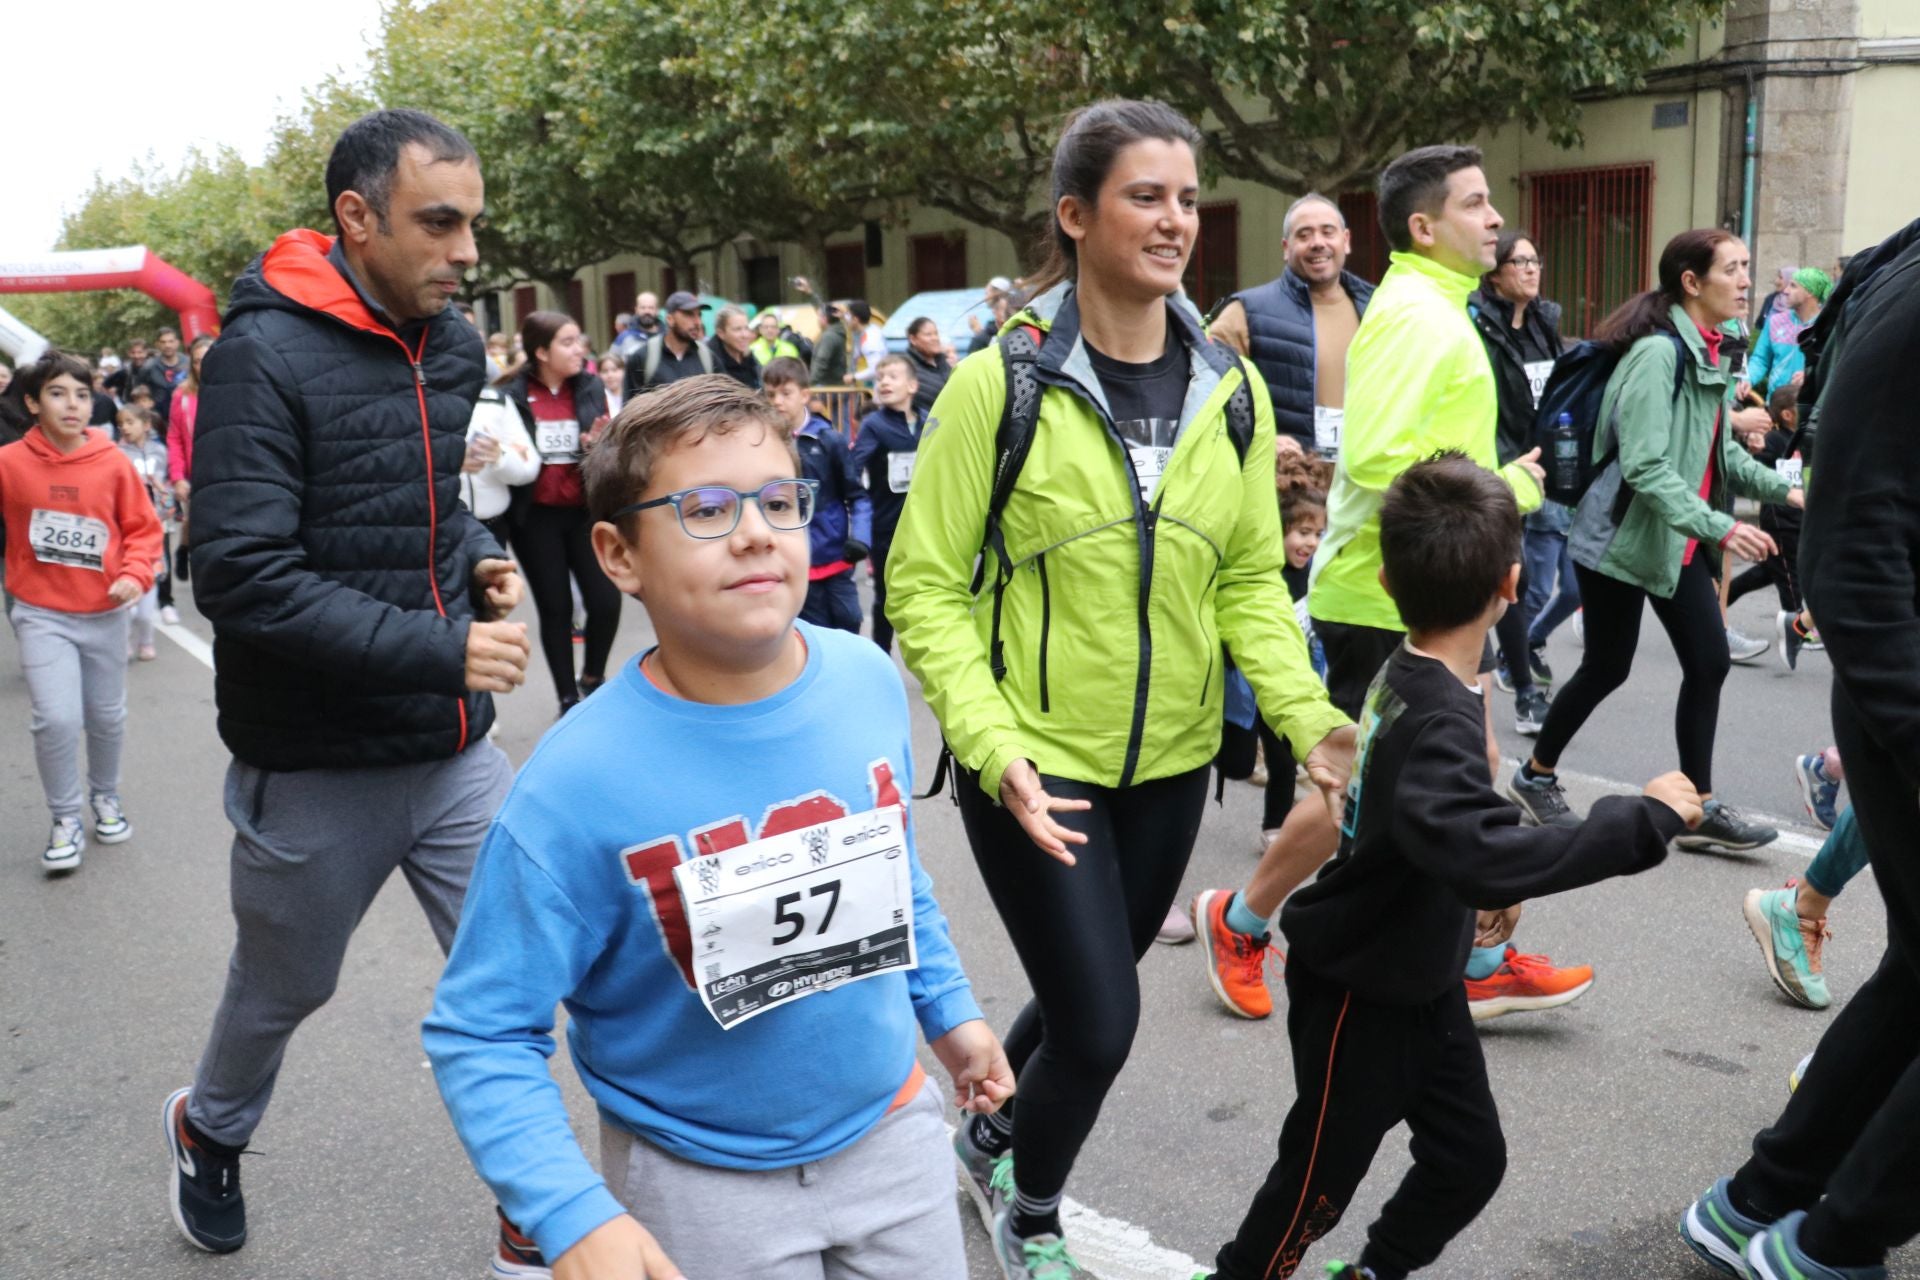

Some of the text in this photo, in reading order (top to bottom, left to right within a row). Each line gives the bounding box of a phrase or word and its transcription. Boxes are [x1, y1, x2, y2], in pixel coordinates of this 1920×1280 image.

[43, 526, 97, 550] 2684
[772, 879, 842, 947] 57
[793, 965, 852, 989] HYUNDAI
